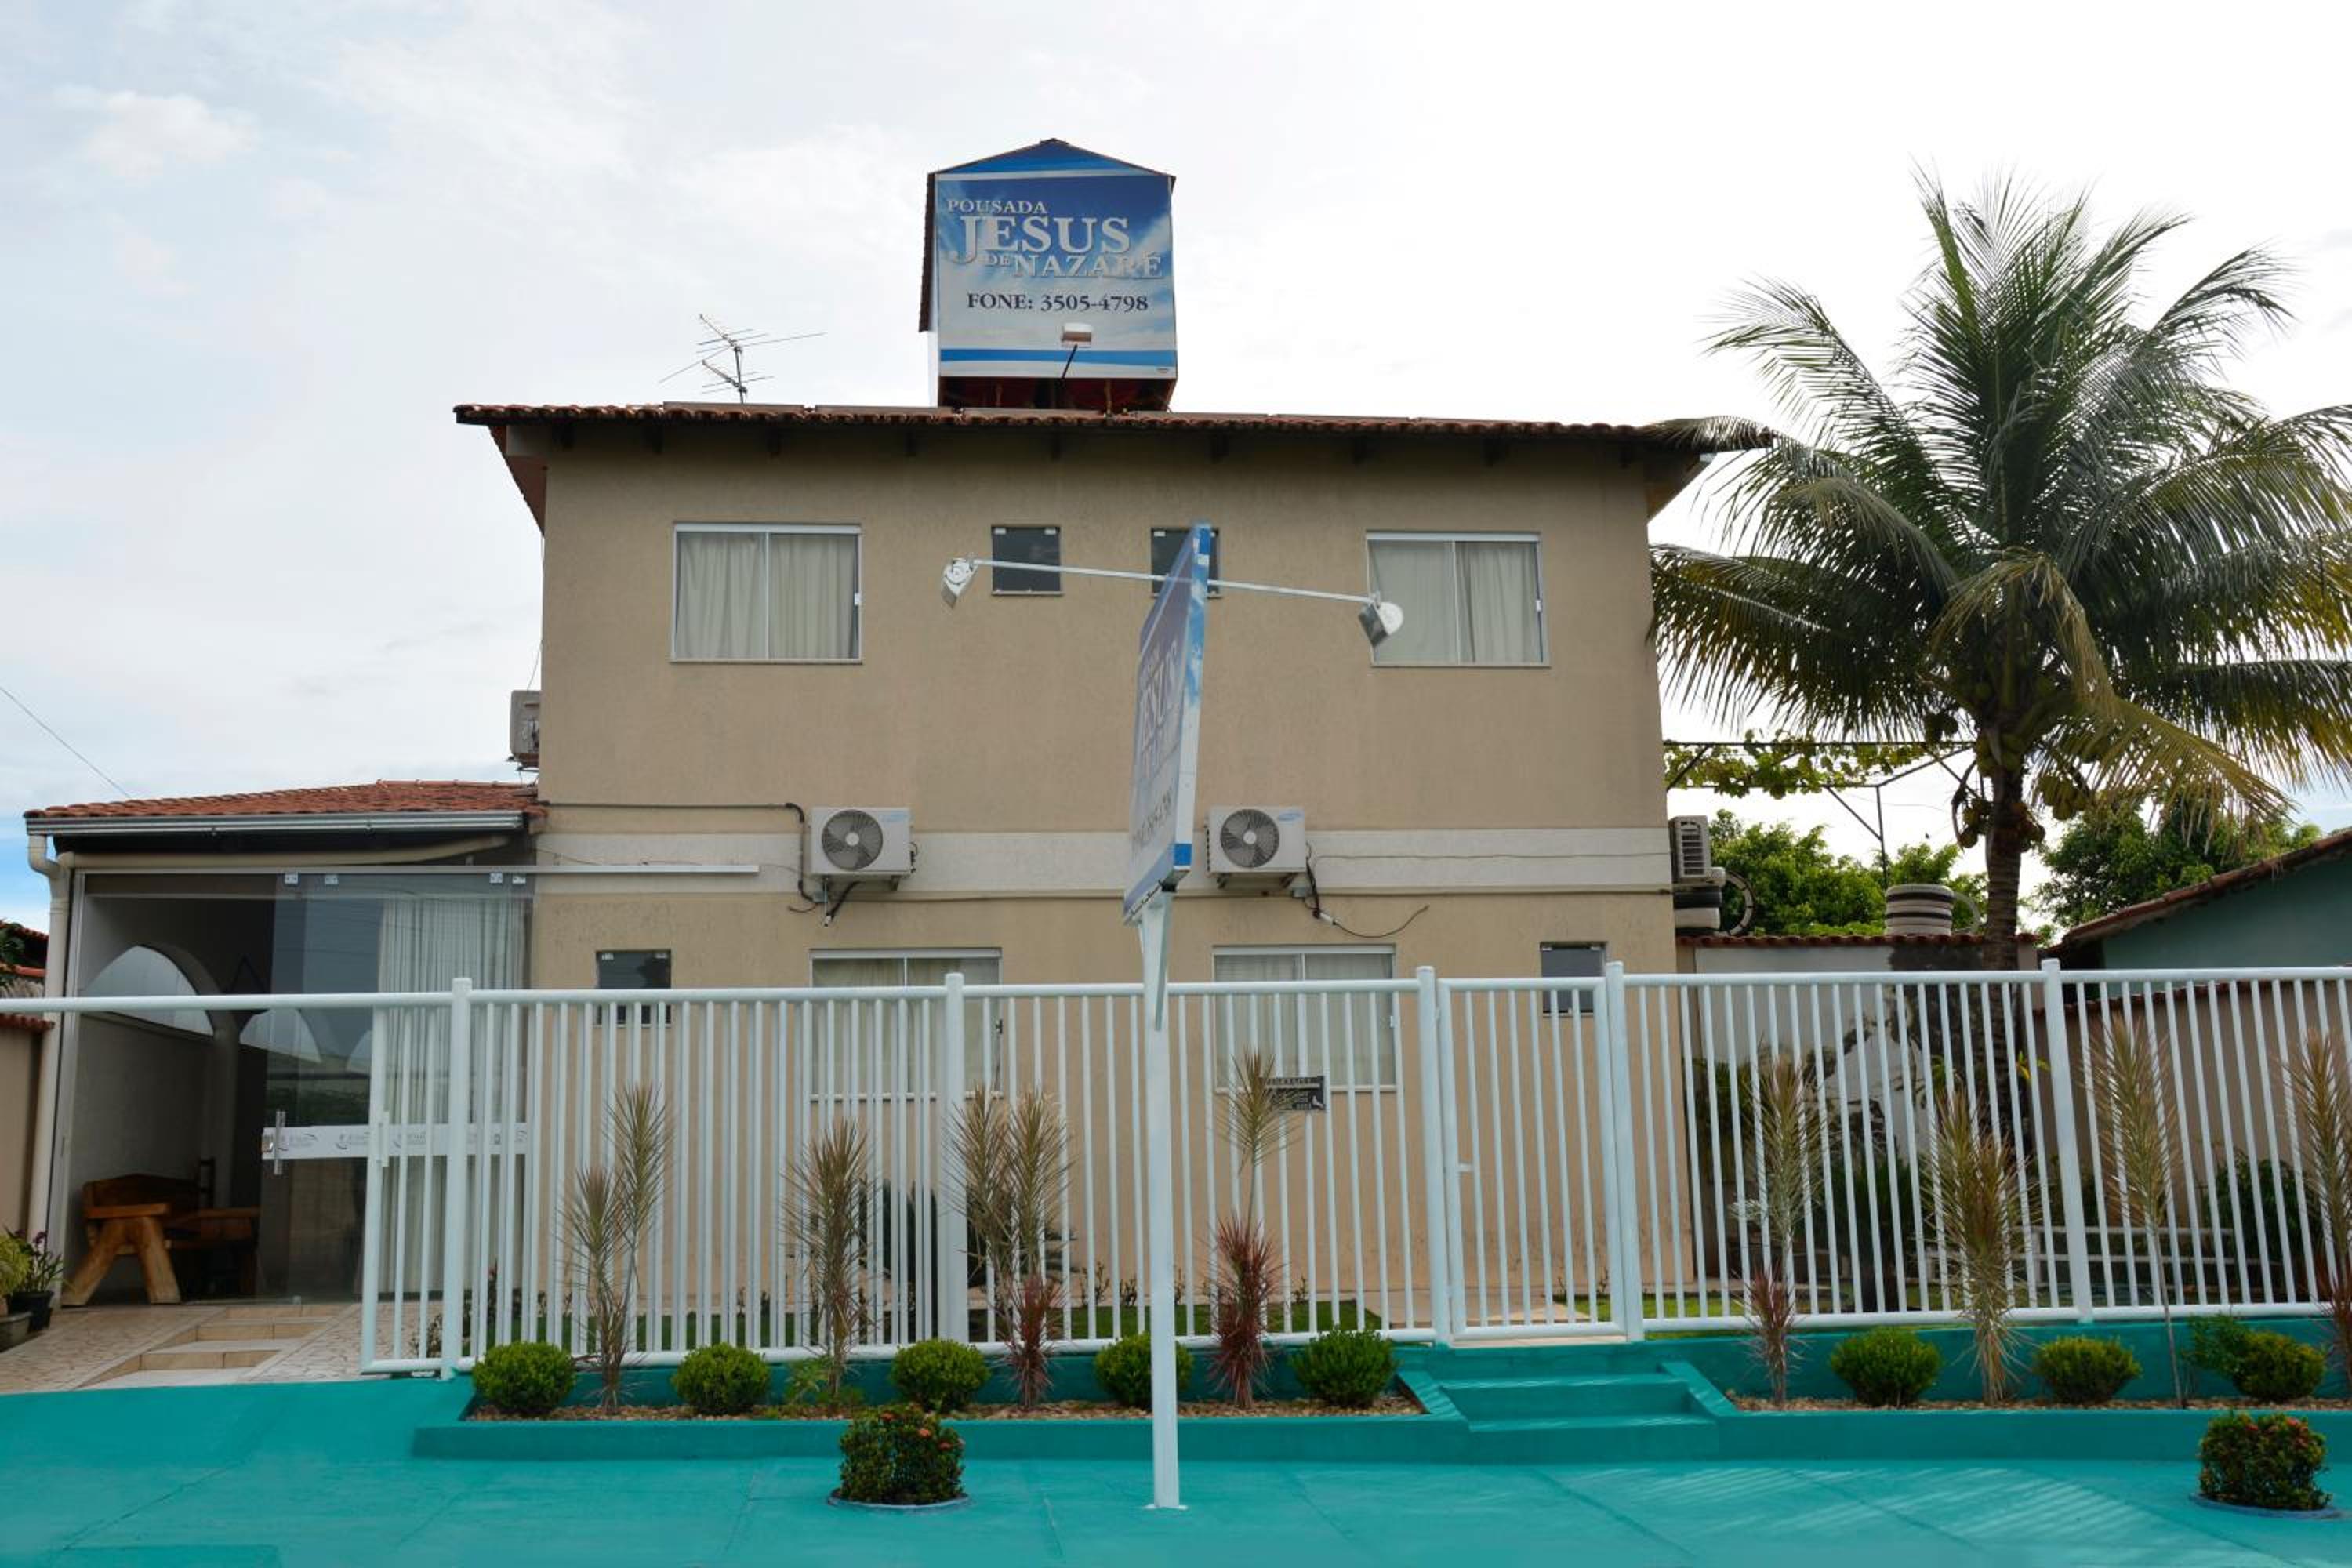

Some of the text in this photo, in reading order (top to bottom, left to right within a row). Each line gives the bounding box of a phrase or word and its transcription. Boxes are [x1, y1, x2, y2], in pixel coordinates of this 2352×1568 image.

[947, 199, 1047, 214] POUSADA
[952, 215, 1131, 264] JESUS
[985, 252, 1011, 267] DE
[967, 292, 1149, 312] FONE: 3505-4798
